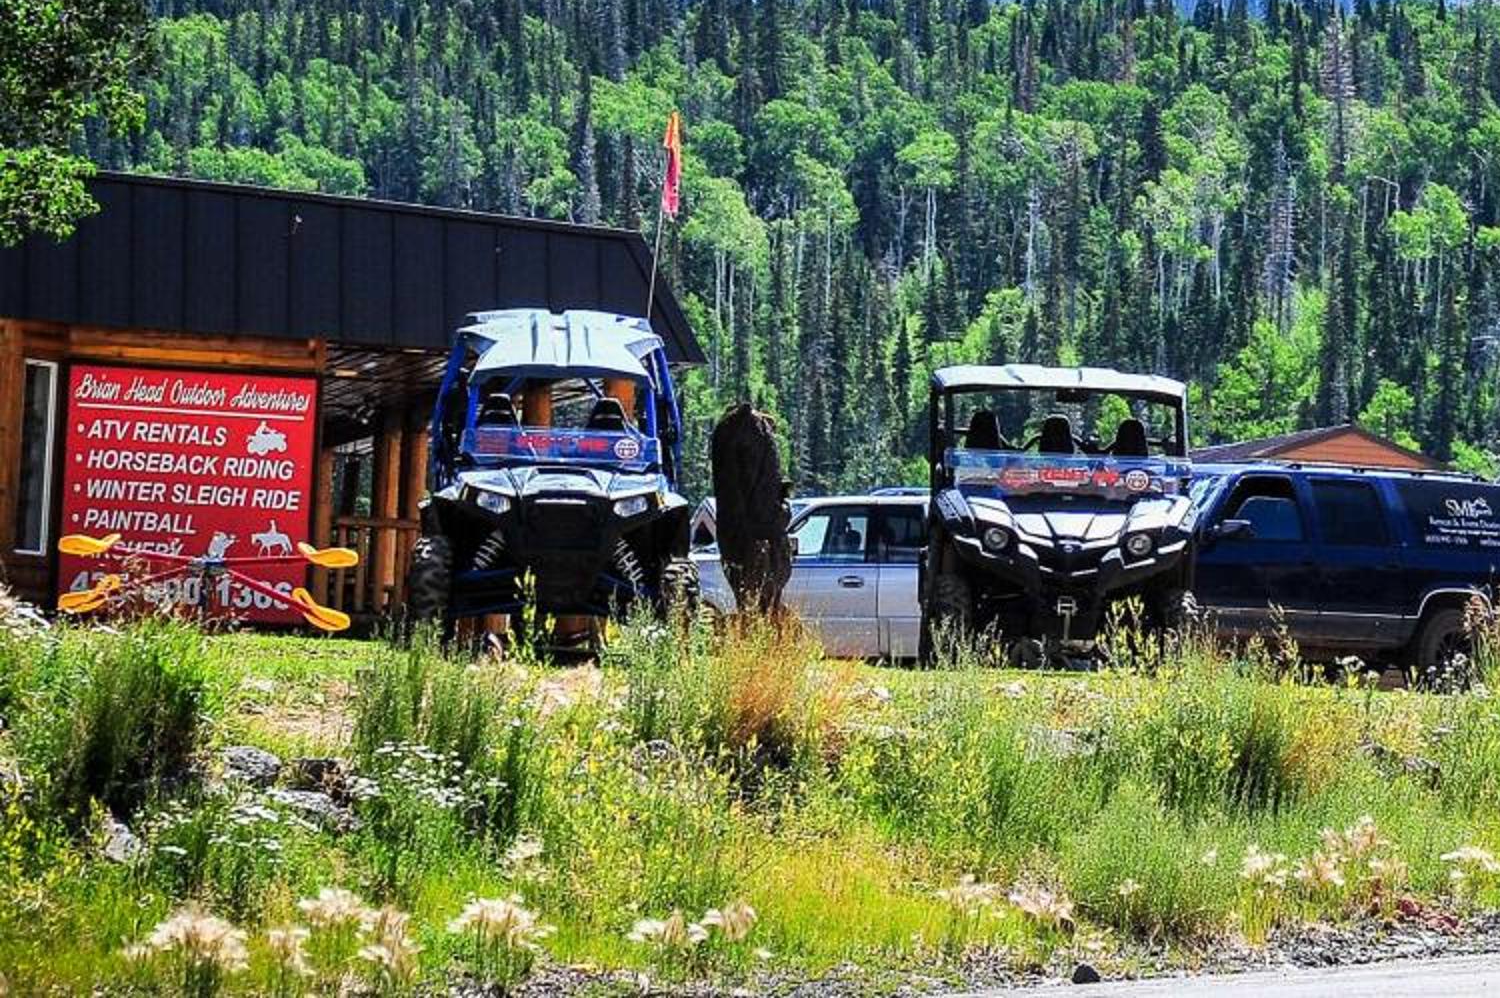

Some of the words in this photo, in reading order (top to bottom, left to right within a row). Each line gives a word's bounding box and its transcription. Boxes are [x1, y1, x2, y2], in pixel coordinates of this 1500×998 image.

[76, 373, 121, 400] Brian
[124, 376, 169, 403] Head
[170, 379, 226, 407] Outdoor
[230, 383, 311, 412] Adventures
[87, 419, 130, 441] ATV
[133, 421, 227, 447] RENTALS
[87, 449, 219, 476] HORSEBACK
[222, 457, 294, 481] RIDING
[87, 478, 167, 503] WINTER
[171, 483, 249, 507] SLEIGH
[251, 488, 302, 511] RIDE
[83, 508, 197, 535] PAINTBALL
